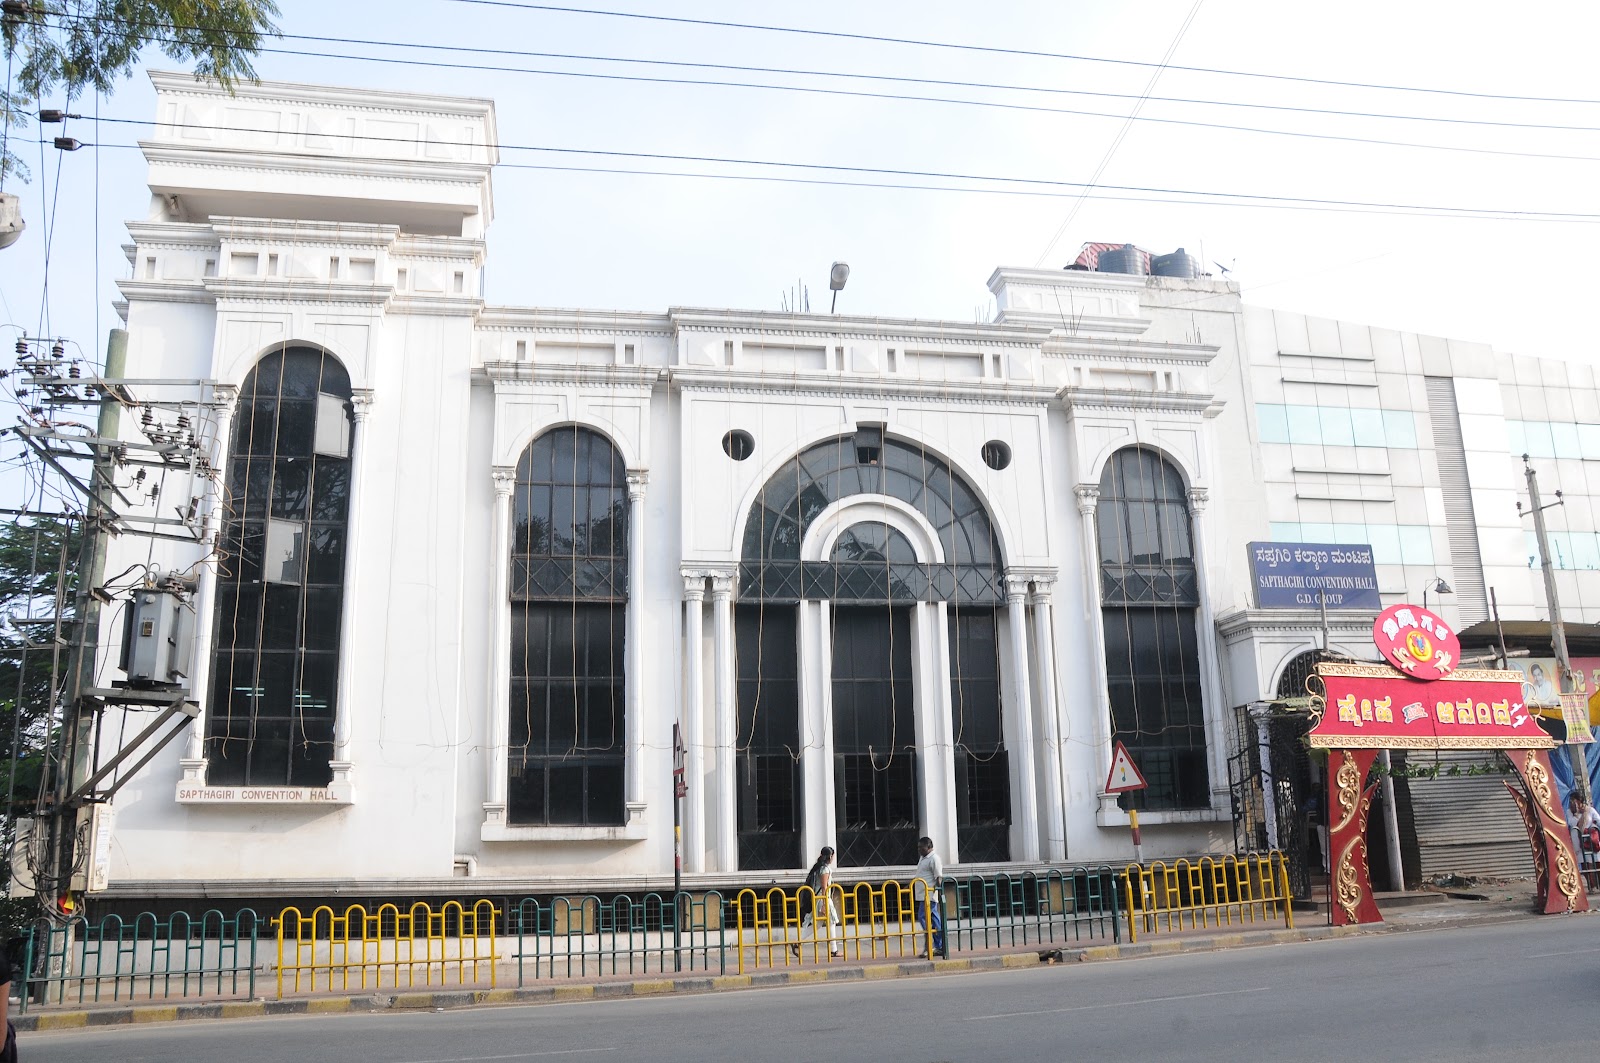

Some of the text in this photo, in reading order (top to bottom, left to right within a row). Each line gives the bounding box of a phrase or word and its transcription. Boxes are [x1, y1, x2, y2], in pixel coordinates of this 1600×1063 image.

[1256, 547, 1371, 570] ಸಪ್ತಗಿರಿ ಕಲ್ಯಾಣ ಮಂಟಪ
[1260, 576, 1376, 589] SAPTHAGIRI CONVENTION HALL
[1296, 594, 1313, 604] G.D.
[1337, 694, 1393, 727] ಸ್ನೇಹ
[1436, 698, 1511, 726] ಆನಂದ
[179, 789, 338, 801] SAPTHAGIRI CONVENTION HALL
